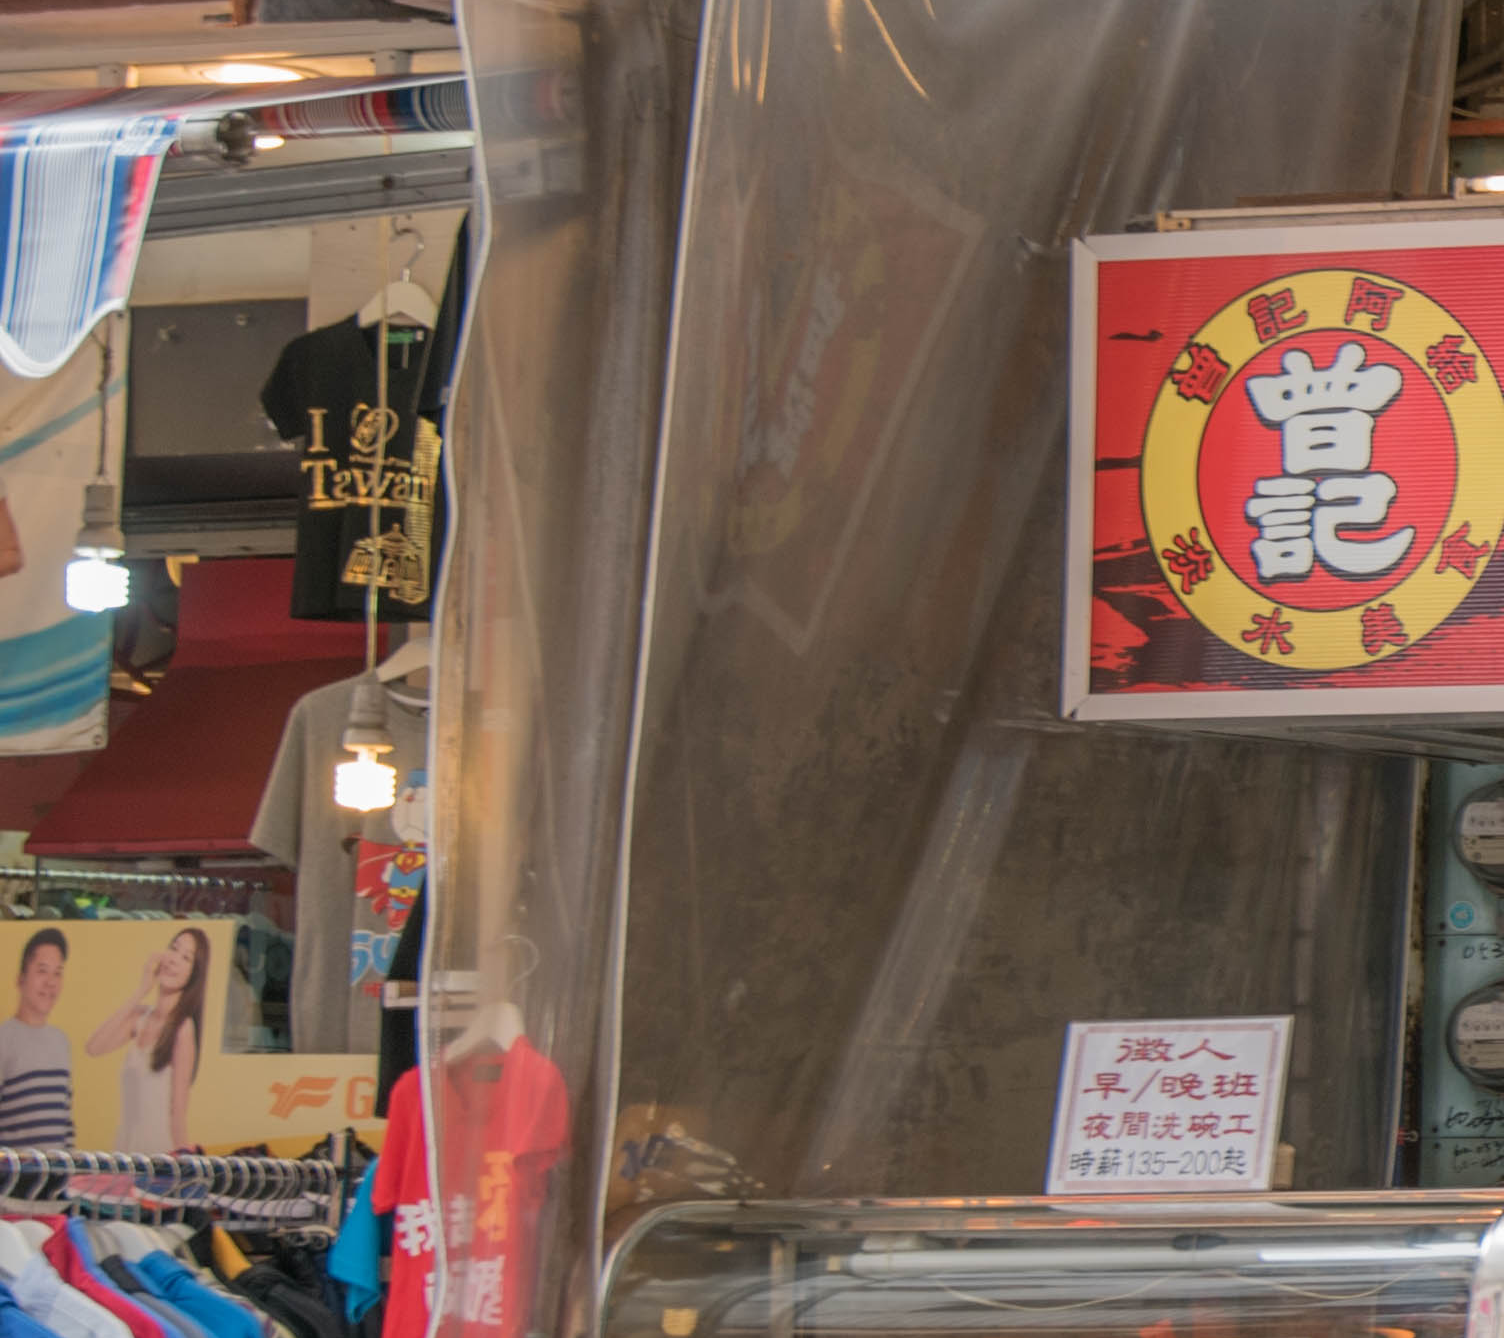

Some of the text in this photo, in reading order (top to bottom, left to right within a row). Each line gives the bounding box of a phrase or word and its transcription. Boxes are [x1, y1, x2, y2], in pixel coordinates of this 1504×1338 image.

[1170, 277, 1478, 404] 曾記阿給
[1245, 341, 1416, 584] 曾記
[1115, 1038, 1236, 1064] 徵人
[1083, 1069, 1260, 1103] 早/晚班
[1082, 1112, 1256, 1141] 夜間洗碗工
